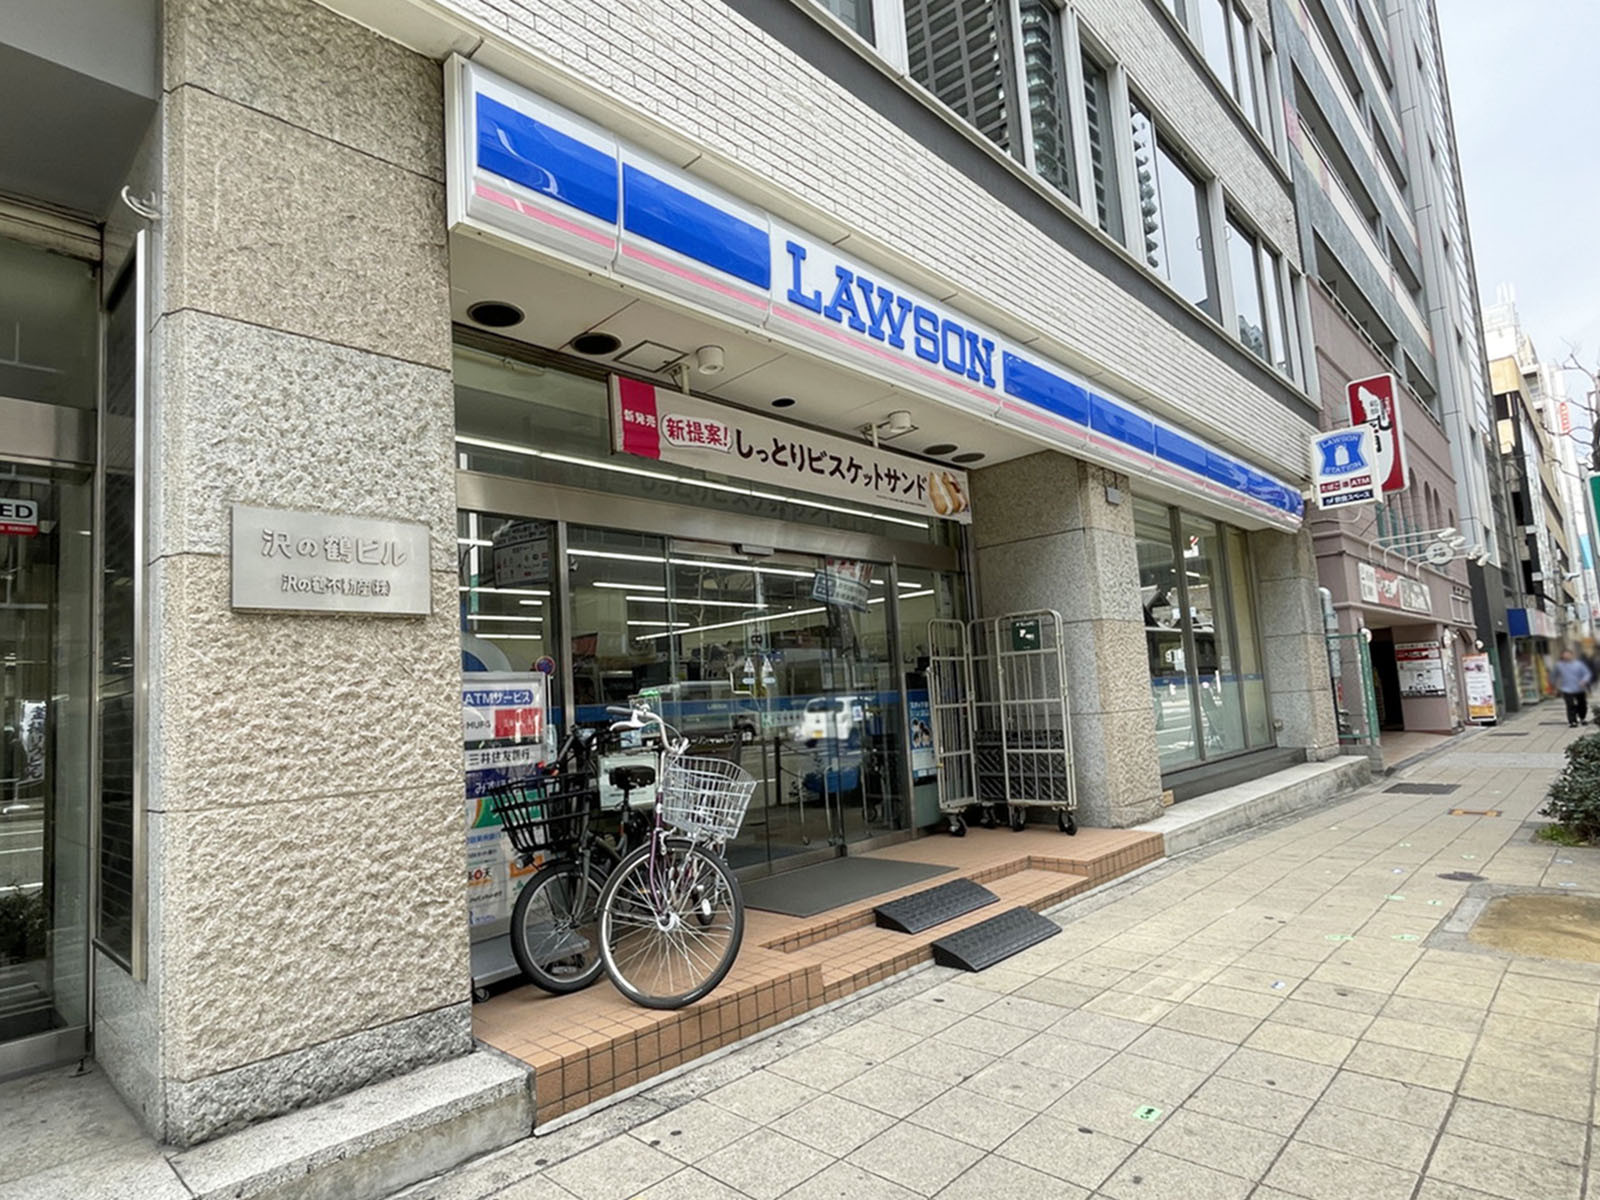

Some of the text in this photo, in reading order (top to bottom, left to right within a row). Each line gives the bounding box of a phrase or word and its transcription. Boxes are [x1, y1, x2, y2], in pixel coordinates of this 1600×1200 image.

[786, 240, 996, 389] LAWSON
[666, 417, 728, 447] 新提案!
[736, 428, 928, 500] しっとりビスケットサンド
[1351, 476, 1370, 486] ATM
[261, 528, 407, 567] 沢の鶴ビル
[464, 691, 531, 705] ATMサービス
[469, 748, 530, 766] 三井住友銀行
